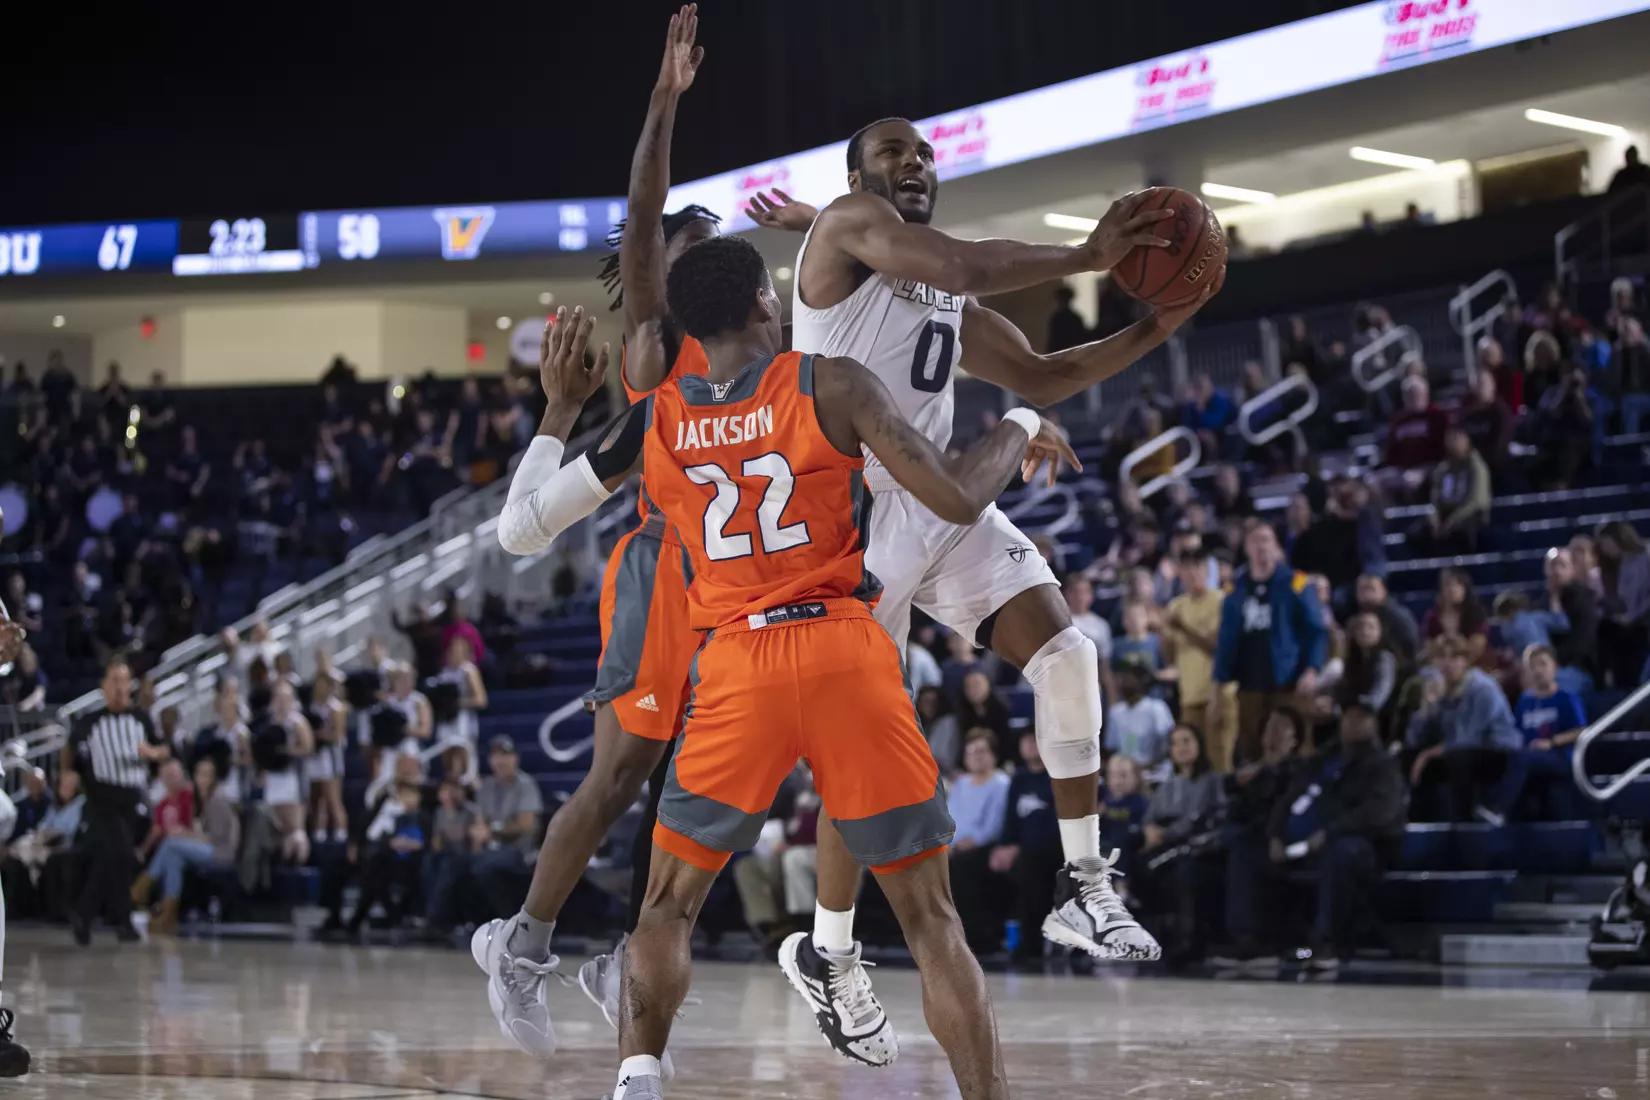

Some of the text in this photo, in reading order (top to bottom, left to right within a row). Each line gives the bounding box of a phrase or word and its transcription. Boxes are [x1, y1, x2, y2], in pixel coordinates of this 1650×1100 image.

[97, 224, 138, 271] 67
[910, 319, 955, 393] 0
[675, 404, 773, 451] JACKSON
[683, 450, 813, 562] 22
